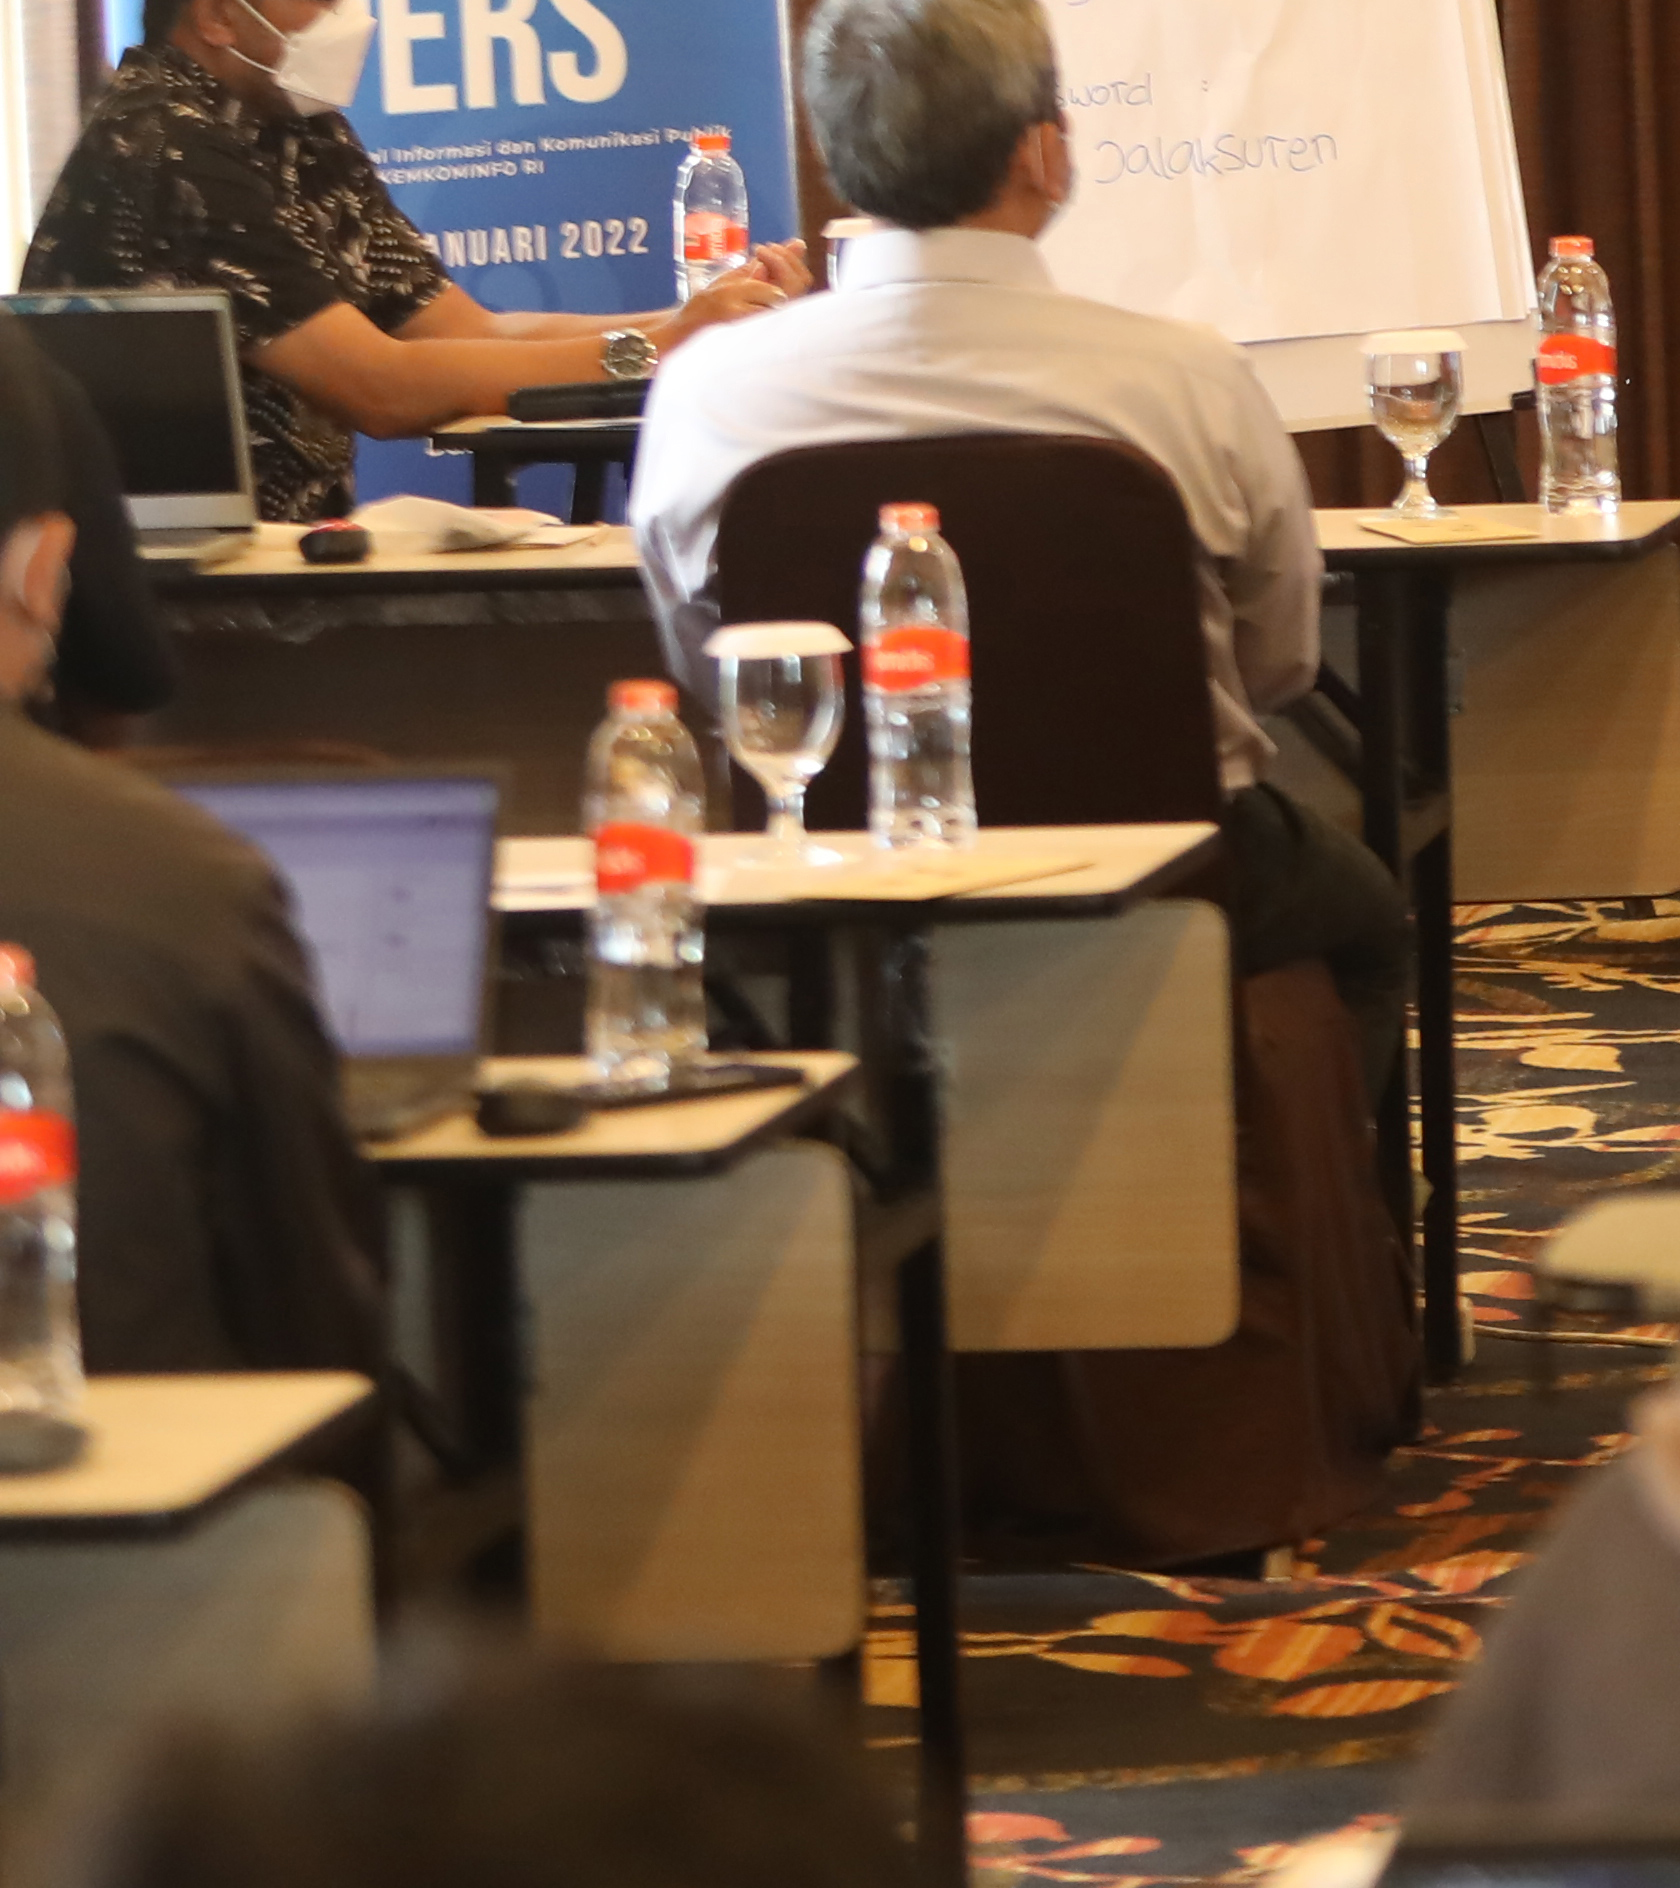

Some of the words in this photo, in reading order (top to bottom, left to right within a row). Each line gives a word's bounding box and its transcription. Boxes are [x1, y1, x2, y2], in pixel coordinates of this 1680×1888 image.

[1054, 72, 1154, 108] sword
[391, 140, 493, 163] Informasi
[496, 139, 537, 156] dan
[538, 128, 661, 153] Komunikasi
[375, 164, 518, 186] KEMKOMINFO
[520, 159, 546, 175] RI
[422, 224, 548, 268] ANUARI
[558, 216, 649, 259] 2022
